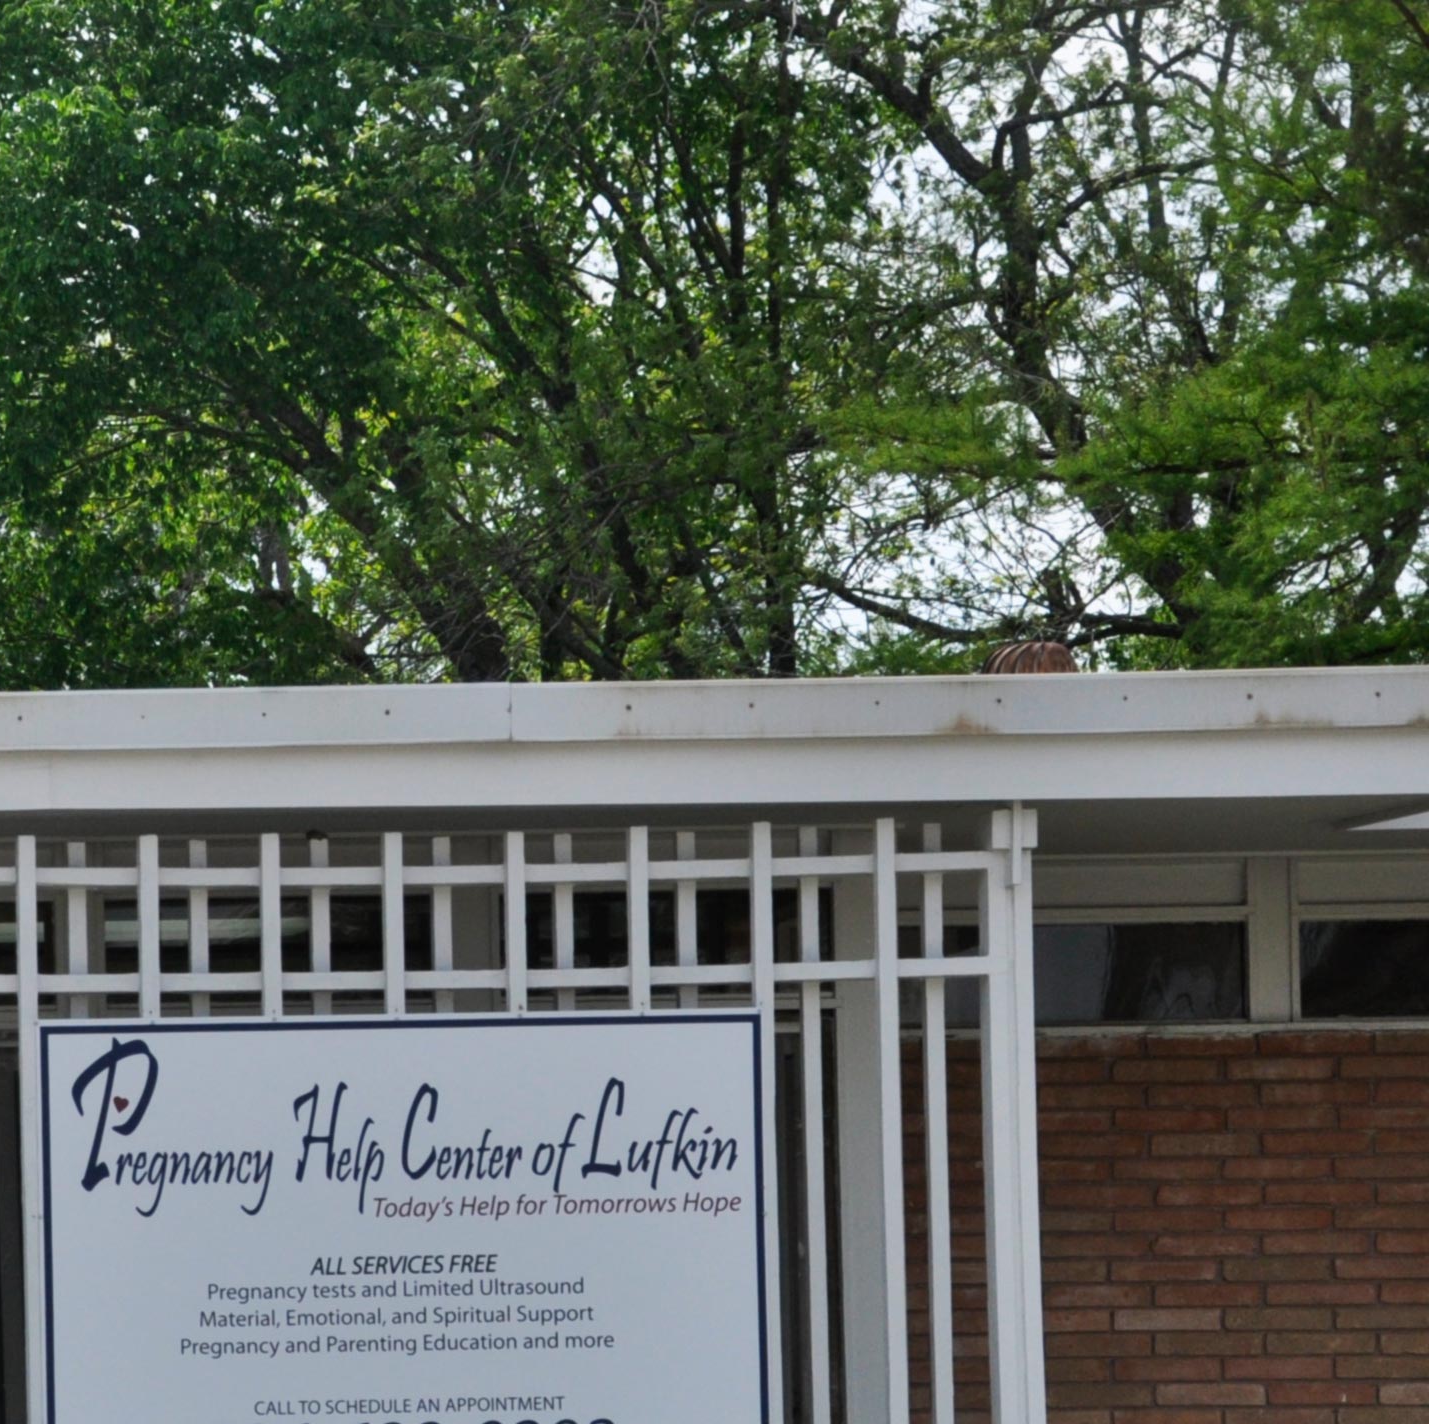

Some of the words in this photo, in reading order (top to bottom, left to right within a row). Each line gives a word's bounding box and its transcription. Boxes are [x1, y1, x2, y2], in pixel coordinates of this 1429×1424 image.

[72, 1037, 274, 1218] Pregnancy
[293, 1081, 385, 1215] Help
[401, 1083, 523, 1181] Center
[531, 1112, 586, 1194] of
[581, 1077, 739, 1190] Lufkin
[373, 1197, 454, 1222] Today's
[459, 1195, 510, 1220] Help
[516, 1193, 549, 1215] for
[552, 1193, 677, 1215] Tomorrows
[682, 1192, 742, 1217] Hope
[310, 1257, 347, 1276] ALL
[351, 1255, 445, 1275] SERVICES
[448, 1253, 499, 1273] FREE
[207, 1283, 307, 1304] Pregnancy
[312, 1282, 356, 1299] tests
[361, 1280, 397, 1298] and
[402, 1279, 474, 1297] Limited
[479, 1277, 585, 1296] Ultrasound
[199, 1309, 281, 1328] Material,
[285, 1307, 387, 1328] Emotional,
[391, 1307, 428, 1324] and
[432, 1305, 511, 1327] Spiritual
[516, 1305, 595, 1326] Support
[180, 1338, 280, 1359] Pregnancy
[285, 1336, 321, 1353] and
[326, 1334, 417, 1357] Parenting
[423, 1333, 518, 1351] Education
[522, 1331, 559, 1350] and
[564, 1334, 616, 1349] more
[253, 1400, 295, 1416] CALL
[298, 1400, 322, 1415] TO
[325, 1398, 412, 1415] SCHEDULE
[415, 1398, 441, 1414] AN
[444, 1396, 566, 1413] APPOINTMENT
